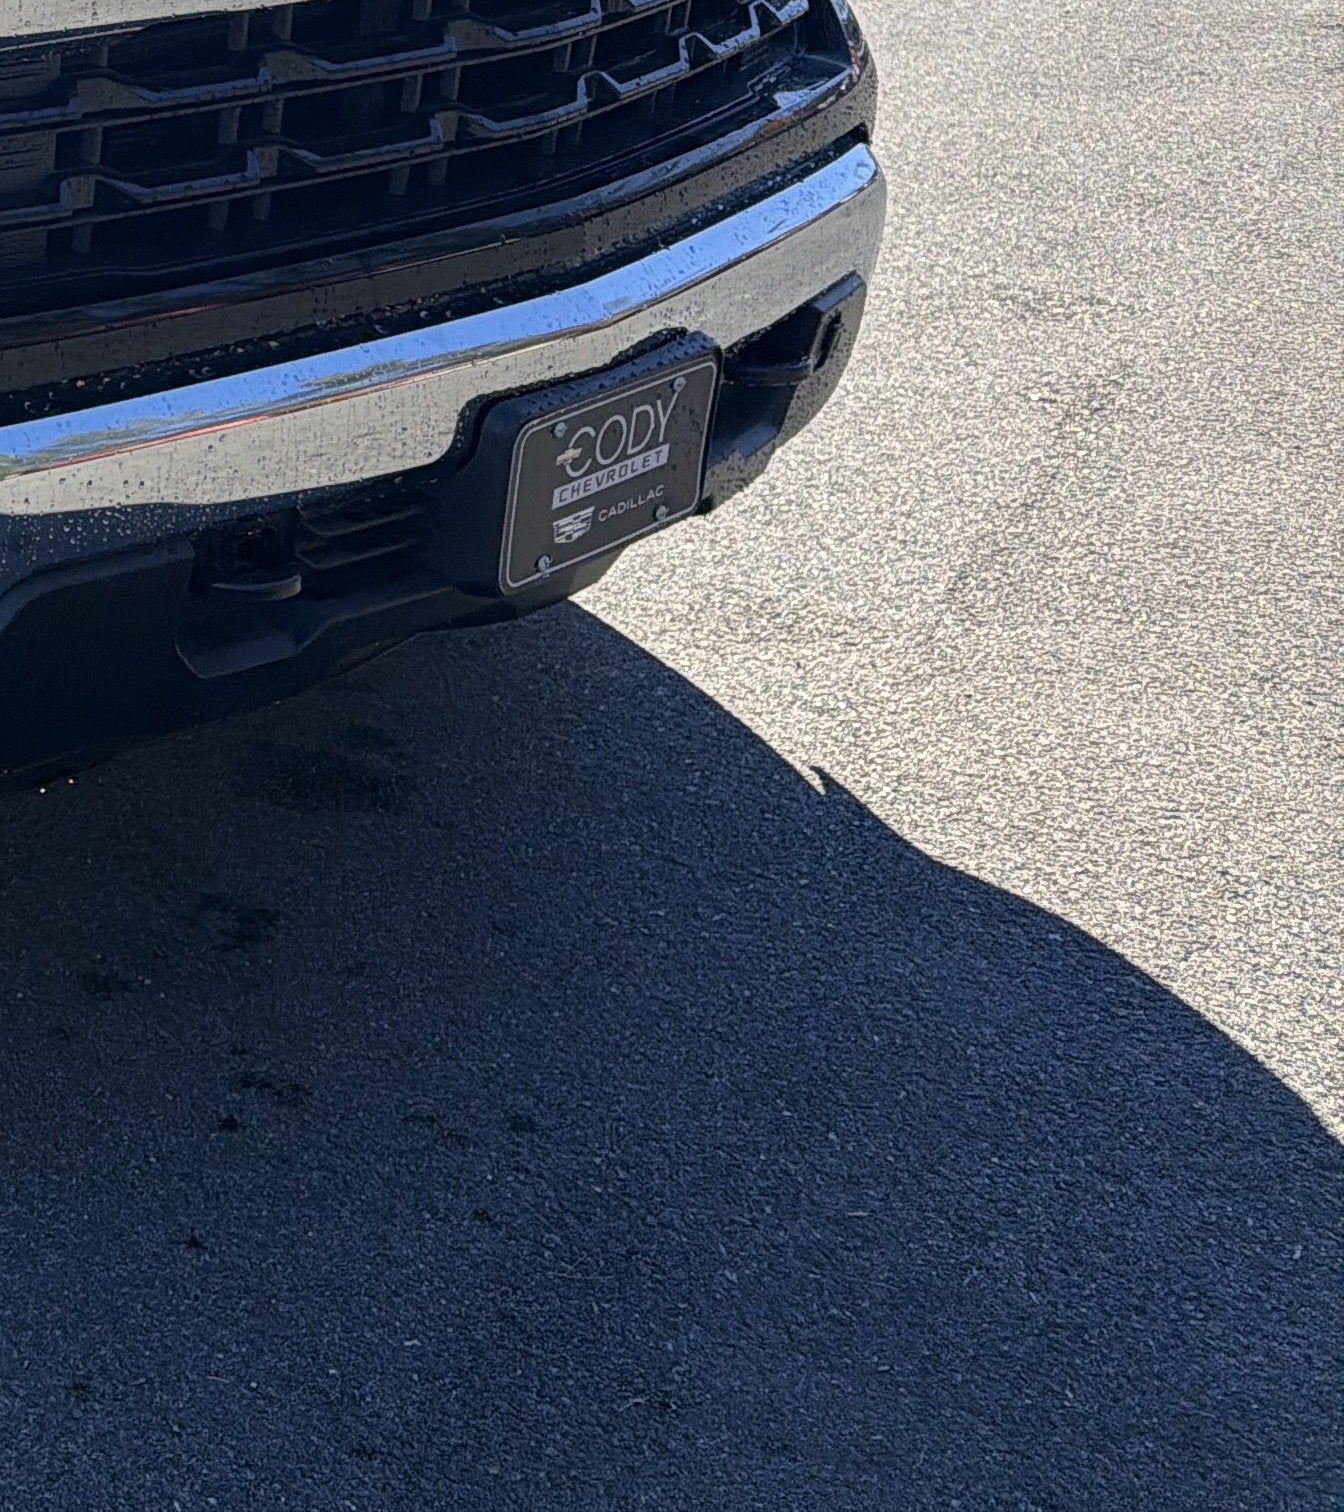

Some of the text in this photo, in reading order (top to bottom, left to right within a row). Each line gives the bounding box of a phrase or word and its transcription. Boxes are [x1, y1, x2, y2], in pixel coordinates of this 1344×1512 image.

[564, 391, 679, 478] CODY
[557, 449, 666, 504] CHEVROLET
[597, 484, 665, 523] CADILLAC
